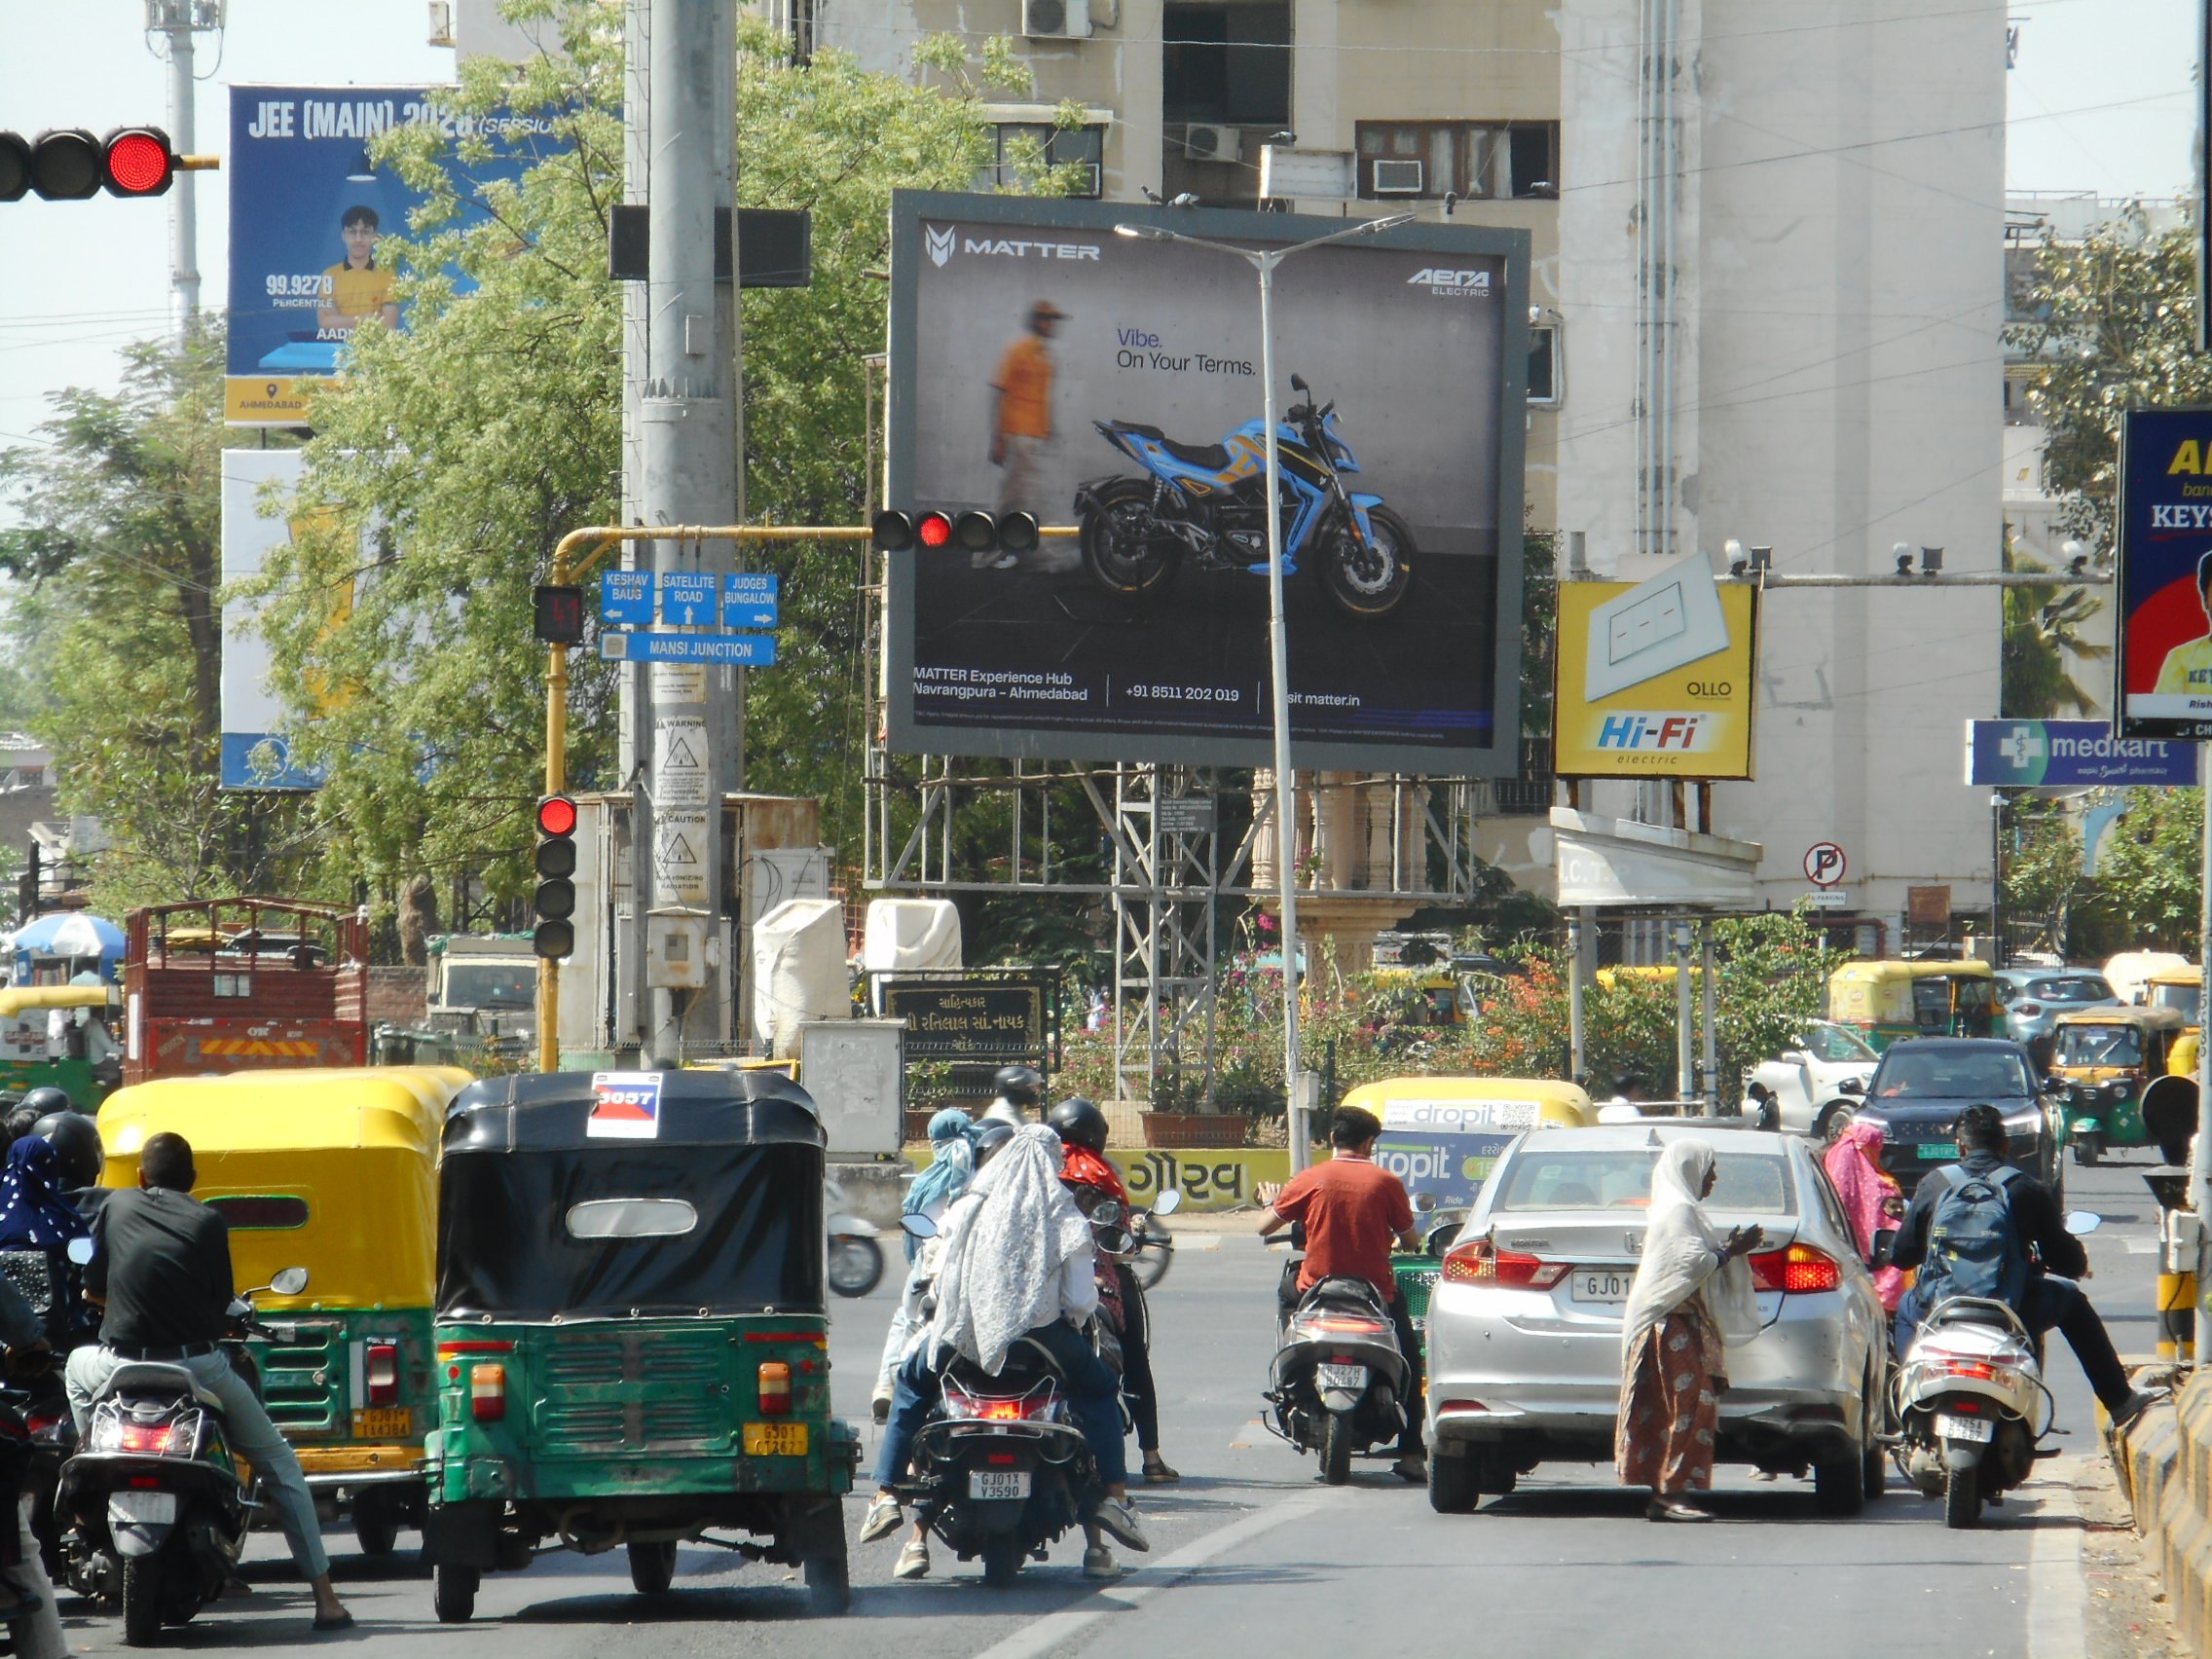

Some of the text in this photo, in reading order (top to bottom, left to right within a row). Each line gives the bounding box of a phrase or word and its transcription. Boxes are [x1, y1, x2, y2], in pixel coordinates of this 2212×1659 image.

[248, 101, 294, 138] JEE
[304, 99, 393, 139] (MAIN)
[965, 239, 1100, 261] MATTER
[266, 275, 333, 296] 99.9278
[1432, 286, 1490, 297] ELECTRIC
[273, 298, 333, 309] PERCENTILE
[1117, 328, 1163, 349] Vibe.
[1117, 350, 1256, 376] On Your Terms.
[240, 400, 303, 410] AHMEDABAD
[607, 574, 648, 586] KESHAV
[664, 576, 716, 588] SATELLITE
[732, 578, 767, 590] JUDGES
[612, 589, 643, 601] BAUG
[675, 591, 703, 603] ROAD
[724, 593, 774, 604] BUNGALOW
[649, 643, 752, 657] MANSI JUNCTION
[913, 667, 1073, 686] MATTER Experience Hub
[912, 682, 996, 699] Navrangpura
[1009, 686, 1088, 701] Ahmedabad
[1125, 685, 1239, 702] +91 8511 202 019
[1686, 682, 1732, 696] OLLO
[1305, 693, 1360, 707] matter.in
[1598, 716, 1699, 749] Hi-Fi
[2052, 733, 2169, 757] medkart
[1617, 754, 1678, 765] electric
[599, 1092, 654, 1105] 3057
[1414, 1104, 1496, 1131] dropit
[1445, 1196, 1464, 1205] Ride
[981, 1474, 1019, 1485] GJ01X
